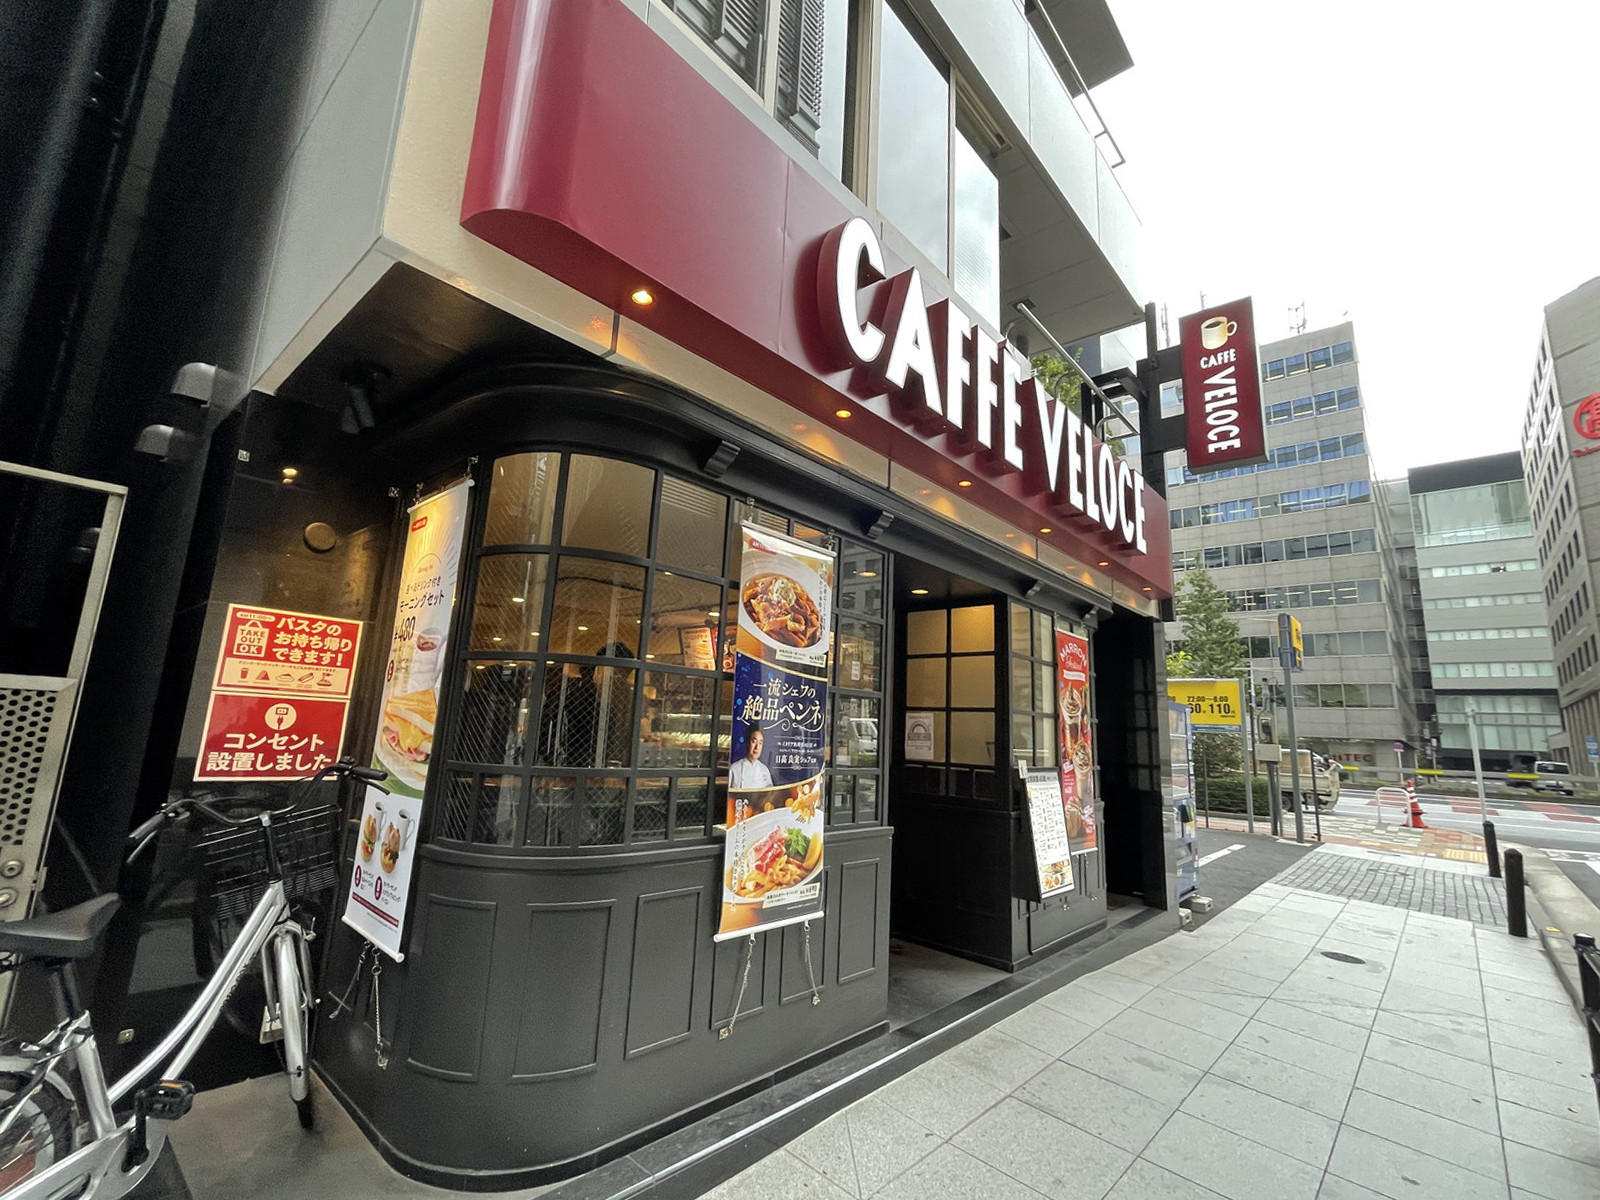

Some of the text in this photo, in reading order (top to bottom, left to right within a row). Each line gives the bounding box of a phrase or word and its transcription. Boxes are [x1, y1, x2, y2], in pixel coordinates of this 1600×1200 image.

[1203, 366, 1242, 454] VELOCE
[1034, 378, 1148, 555] VELOCE
[400, 590, 444, 613] モーニングセット
[240, 628, 266, 638] TAKE
[277, 616, 341, 636] パスタの
[240, 636, 262, 644] OUT
[240, 644, 259, 655] OK
[273, 631, 352, 652] お持ち帰り
[753, 678, 816, 699] 一流シェフの
[743, 694, 822, 726] 絶品ペンネ
[223, 732, 325, 752] コンセント
[206, 751, 333, 772] 設置しました
